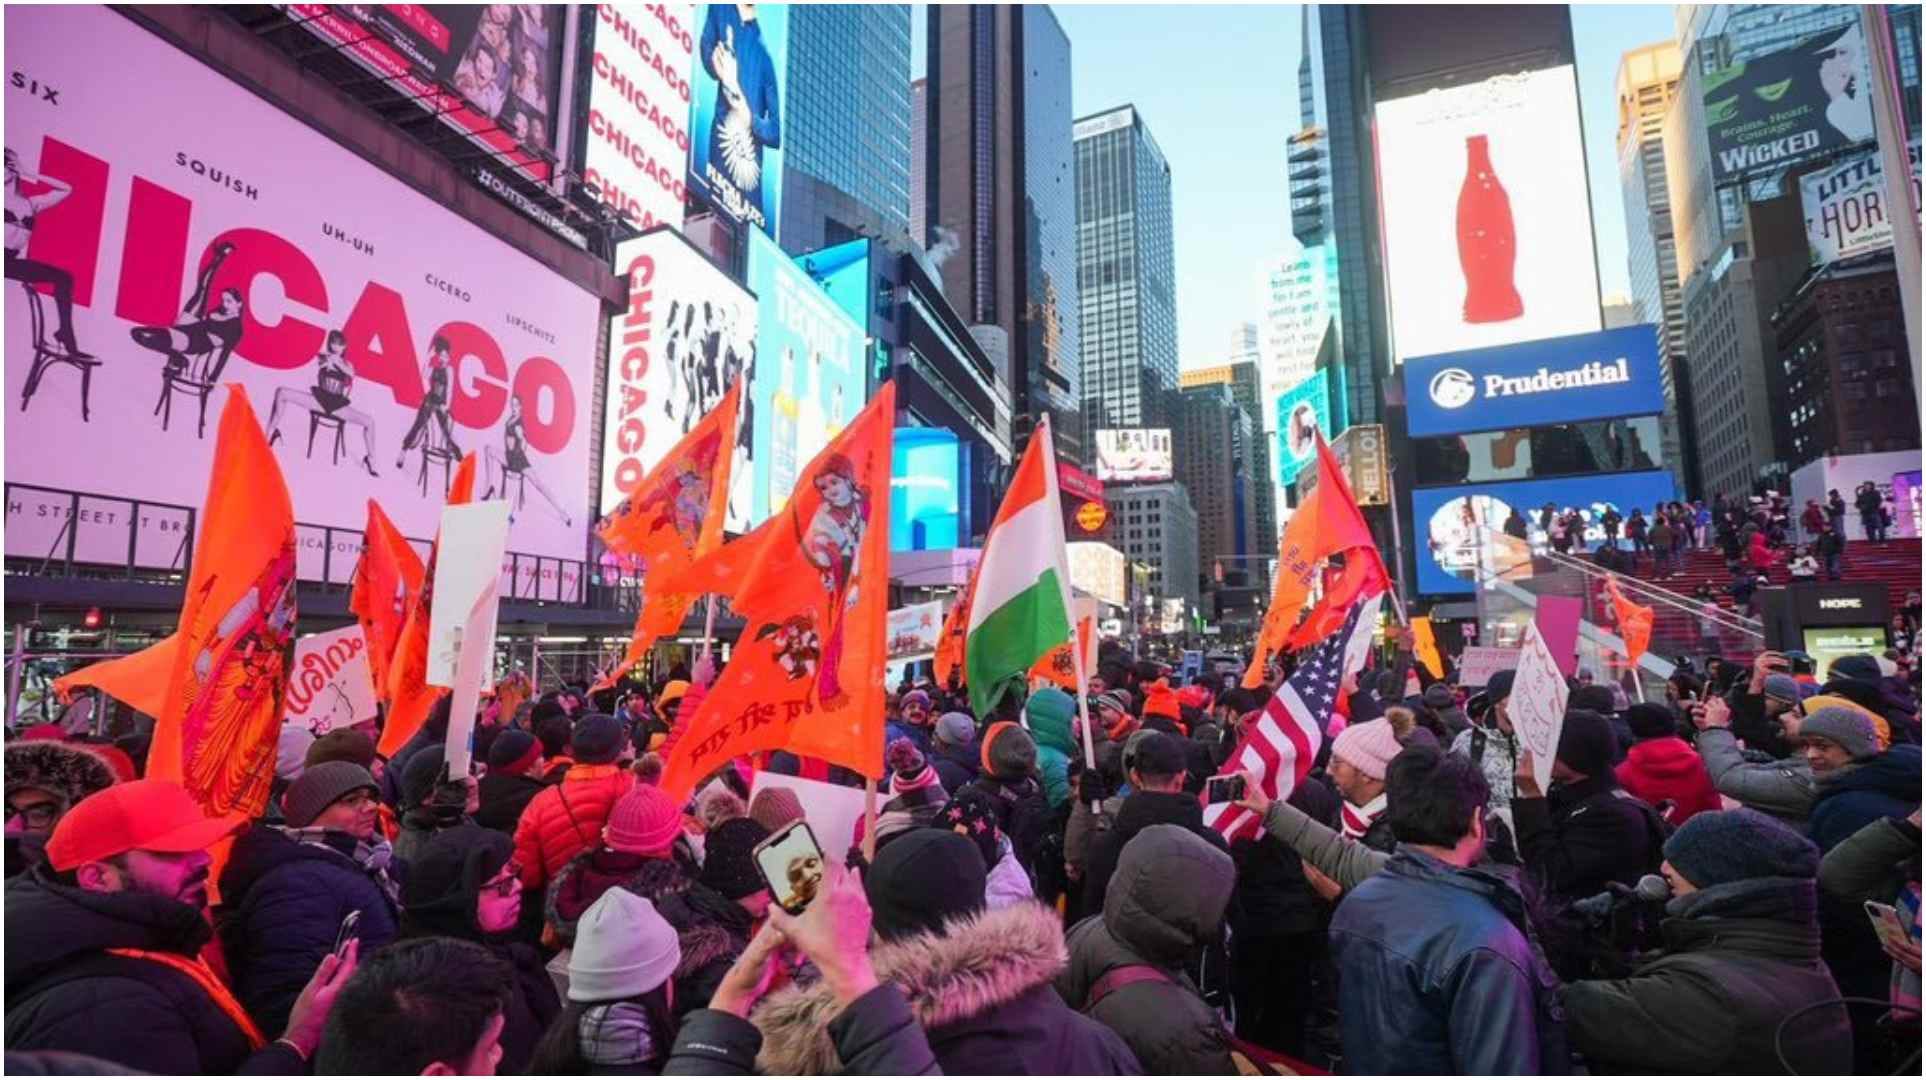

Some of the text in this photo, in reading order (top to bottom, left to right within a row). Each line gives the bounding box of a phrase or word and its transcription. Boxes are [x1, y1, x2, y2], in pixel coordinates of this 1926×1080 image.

[598, 3, 691, 102] CHICAGO
[11, 71, 60, 105] SIX
[592, 50, 689, 151] CHICAGO
[176, 151, 258, 200] SQUISH
[588, 109, 688, 203] CHICAGO
[322, 222, 375, 256] UH-UH
[1821, 191, 1883, 250] HOR
[425, 273, 472, 303] CICERO
[505, 313, 556, 345] LIPSCHITZ
[613, 254, 656, 493] CHICAGO
[1484, 358, 1630, 398] Prudential
